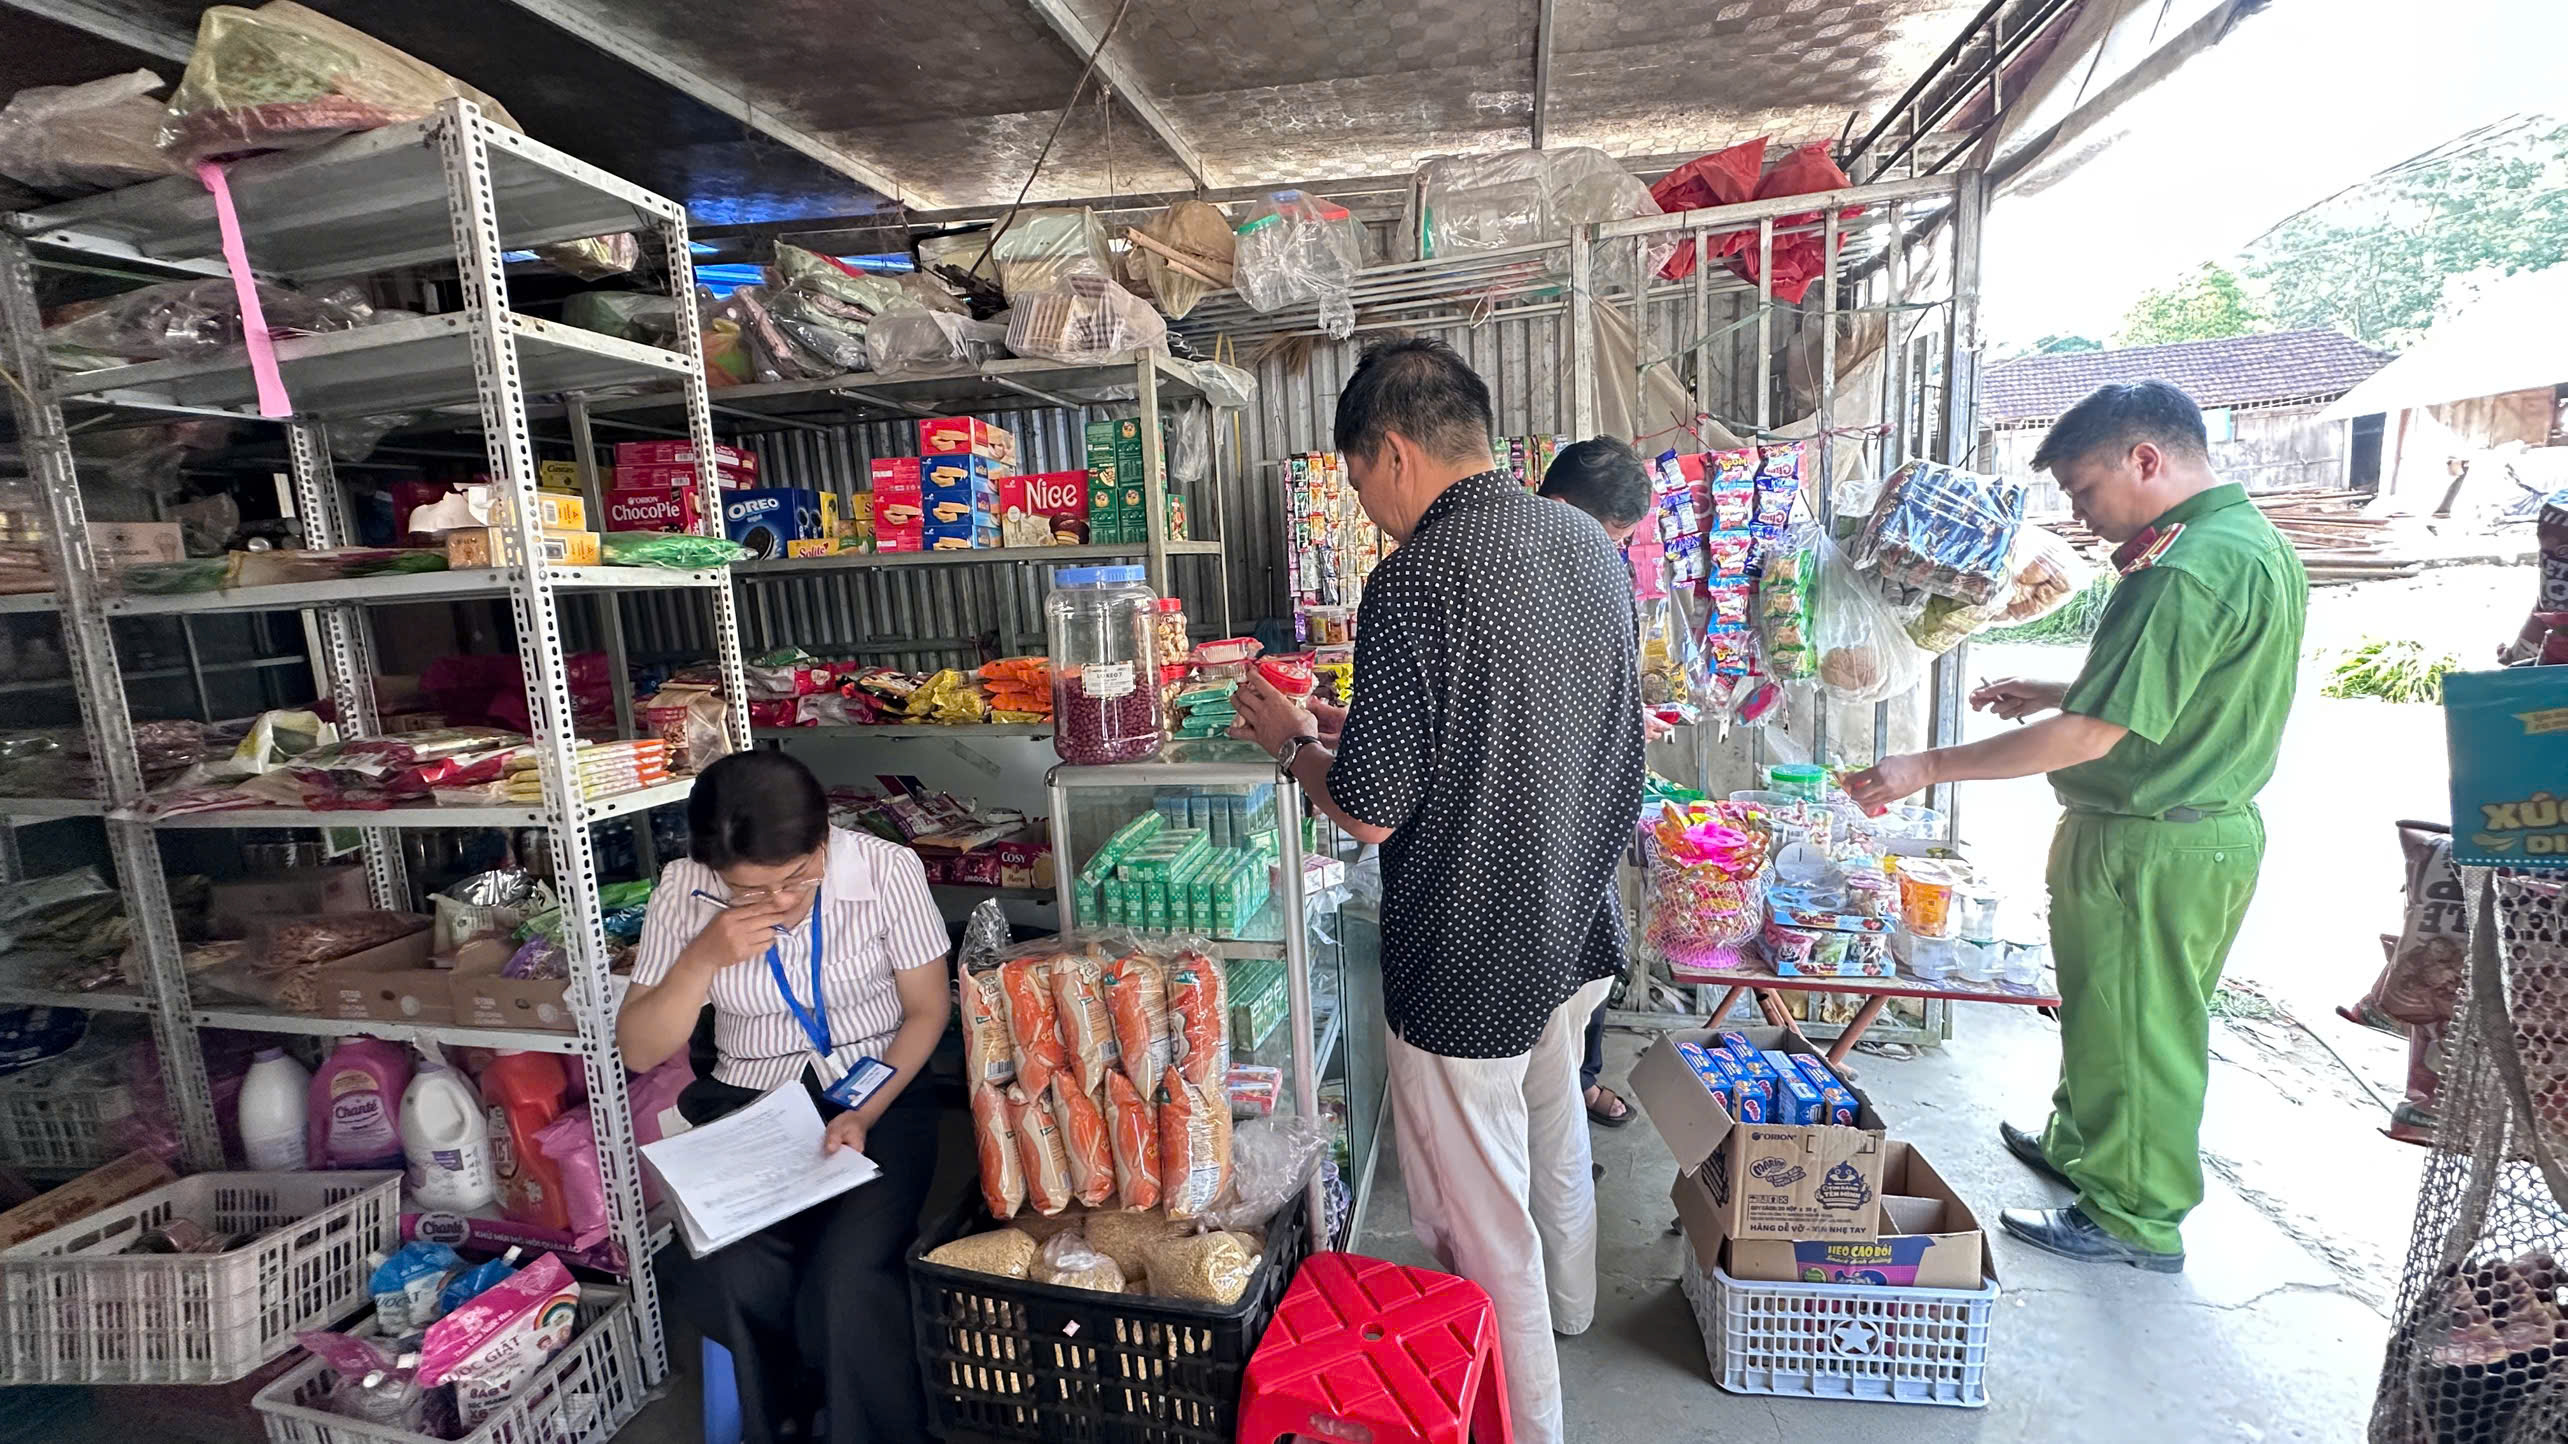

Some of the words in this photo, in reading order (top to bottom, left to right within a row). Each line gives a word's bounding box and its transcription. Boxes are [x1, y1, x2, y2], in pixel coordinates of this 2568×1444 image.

[1025, 478, 1078, 518] Nice
[612, 501, 680, 521] ChocoPie
[728, 498, 779, 519] OREO
[335, 1100, 378, 1119] Chanté
[422, 1219, 464, 1236] Chanté
[1850, 1226, 1867, 1234] TAY
[1851, 1245, 1874, 1258] CAO
